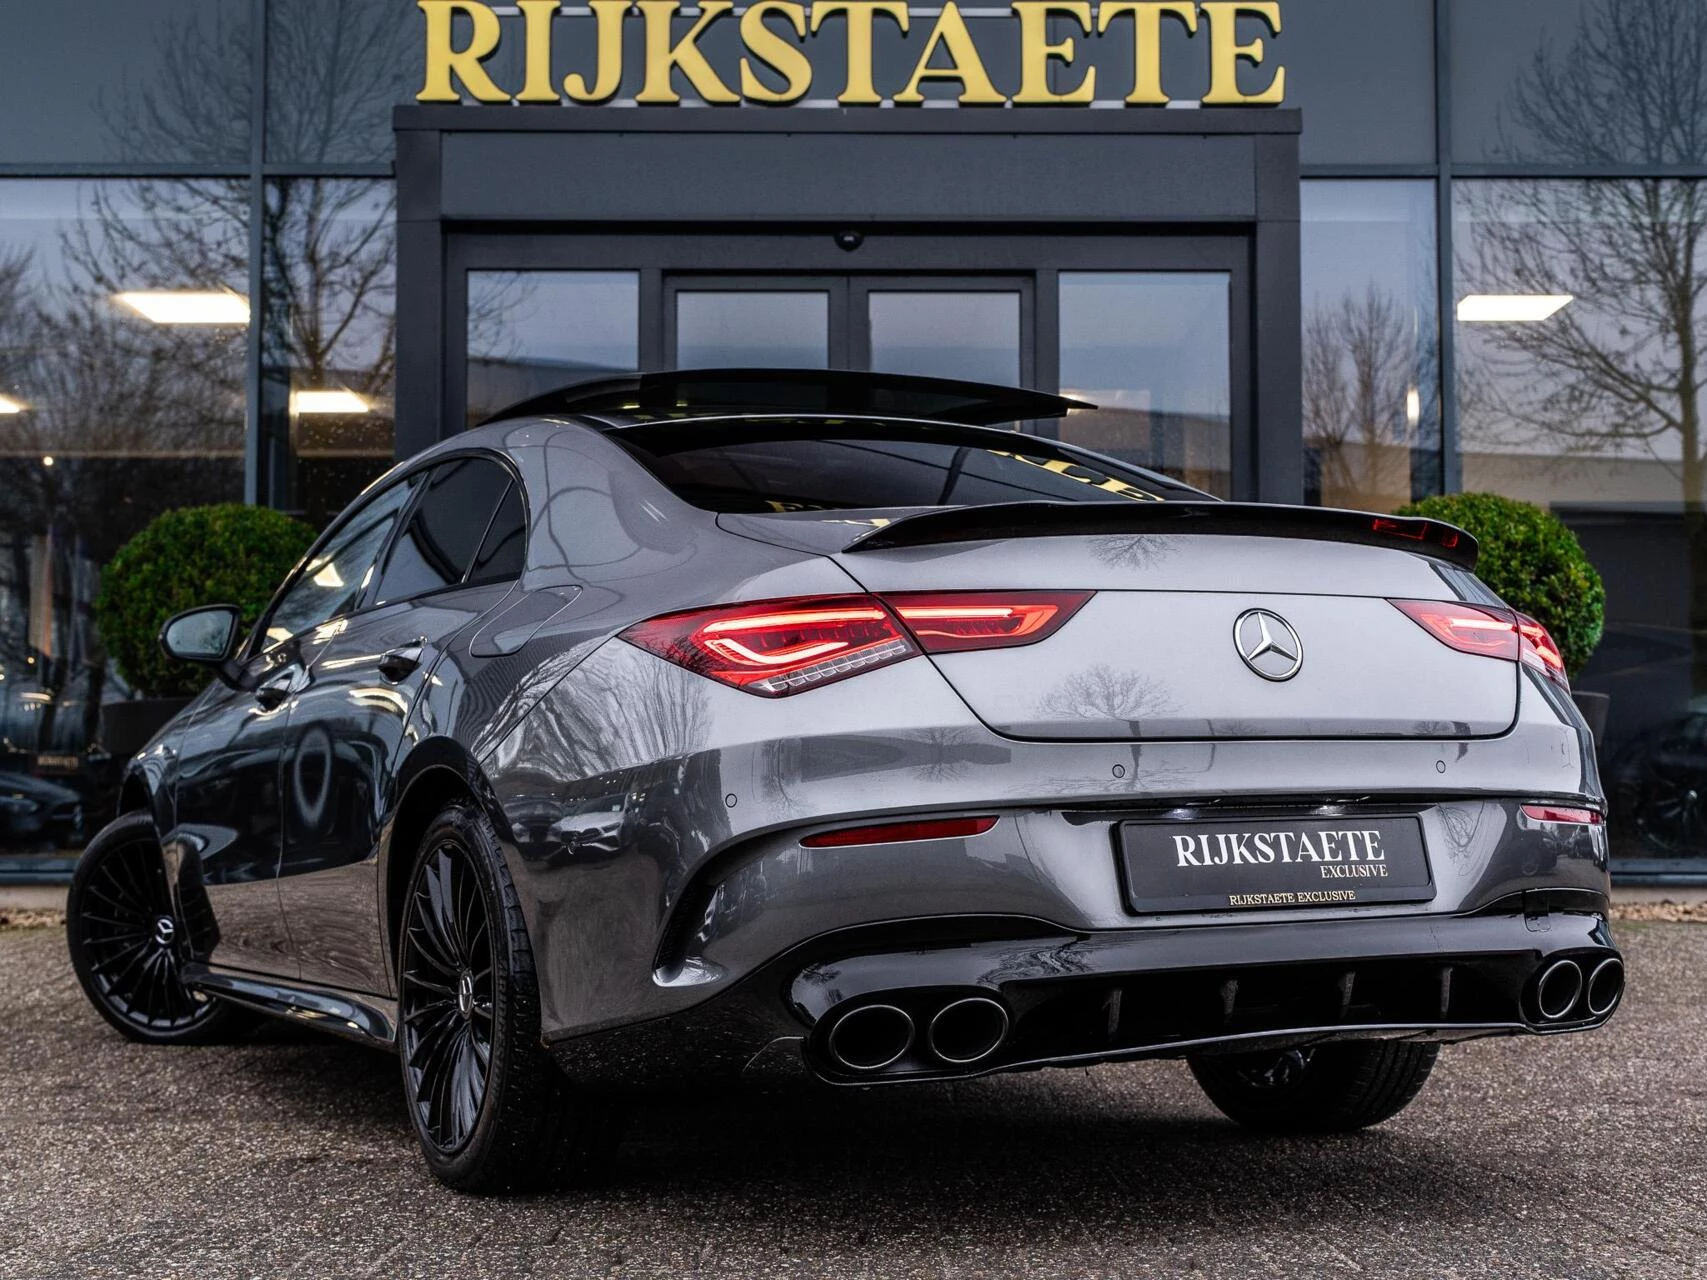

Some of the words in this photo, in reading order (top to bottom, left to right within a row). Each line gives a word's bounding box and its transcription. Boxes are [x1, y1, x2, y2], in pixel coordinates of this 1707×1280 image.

[416, 0, 1286, 106] RIJKSTAETE
[1172, 830, 1385, 867] RIJKSTAETE
[1320, 864, 1388, 879] EXCLUSIVE
[1229, 892, 1295, 906] RIJKSTAETE
[1297, 890, 1356, 902] EXCLUSIVE
